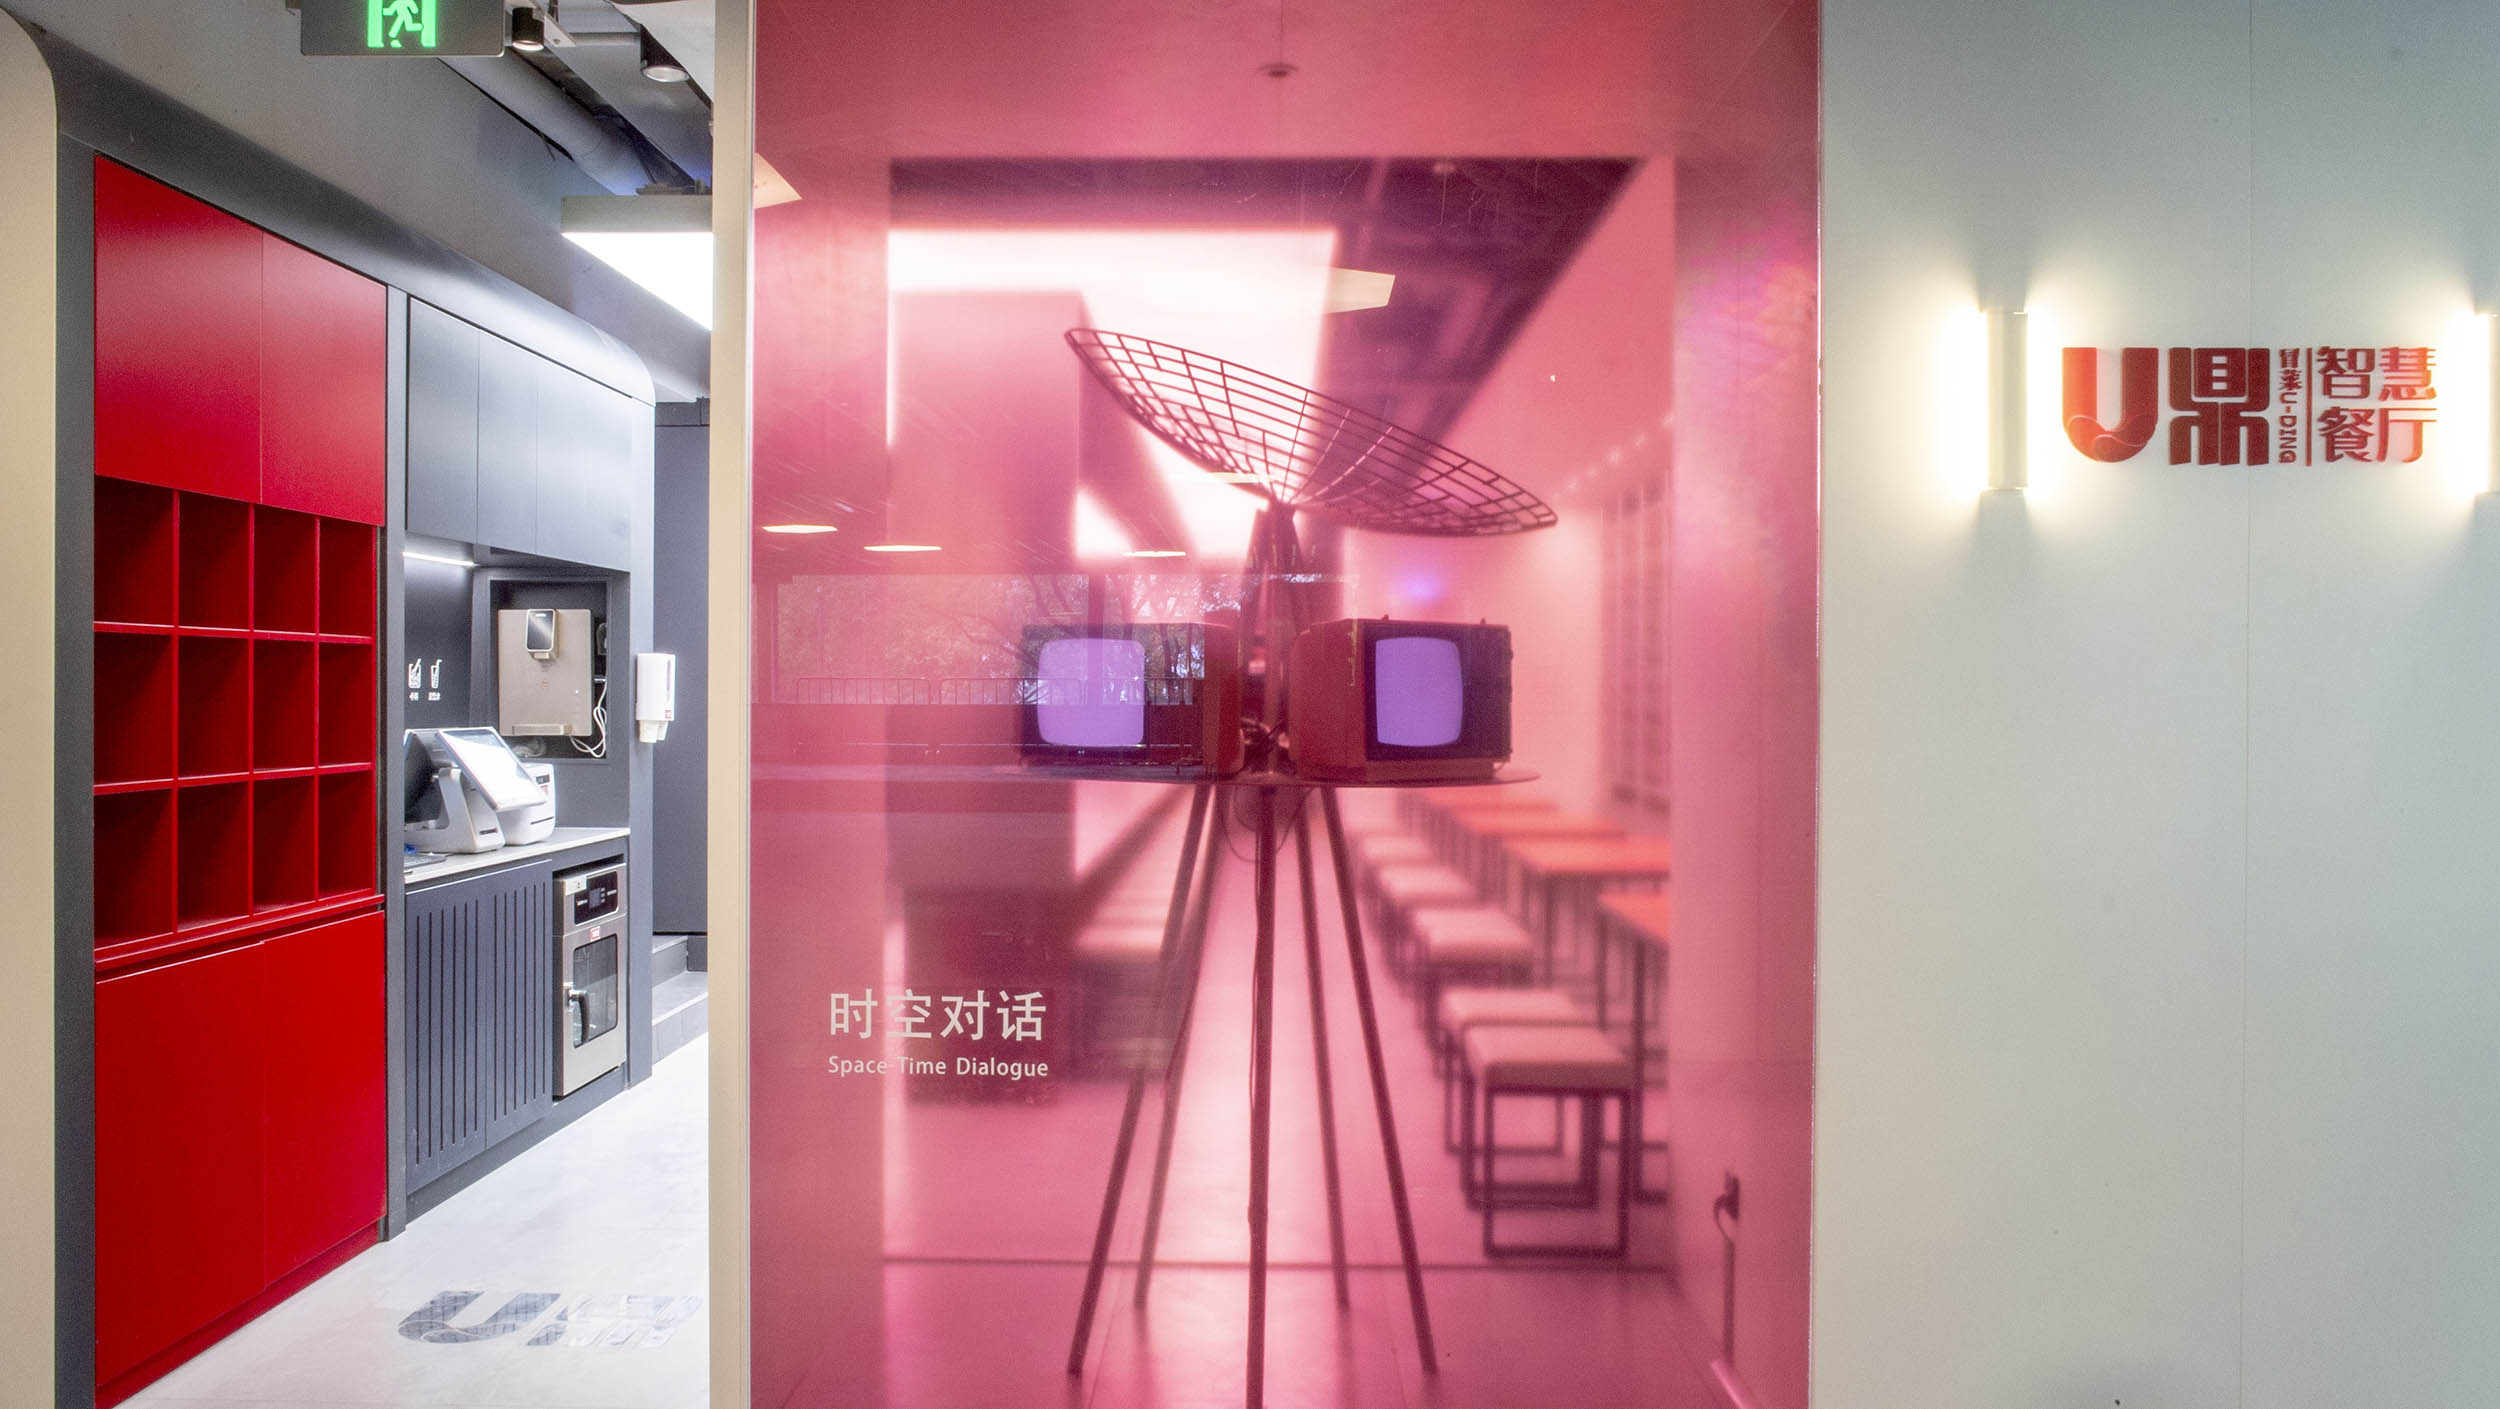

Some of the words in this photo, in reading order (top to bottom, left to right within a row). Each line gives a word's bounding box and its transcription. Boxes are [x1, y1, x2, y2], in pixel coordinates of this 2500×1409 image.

[2316, 346, 2437, 400] 智慧
[2316, 407, 2437, 463] 餐厅
[830, 988, 1047, 1041] 时空对话
[956, 1057, 1049, 1080] Dialogue
